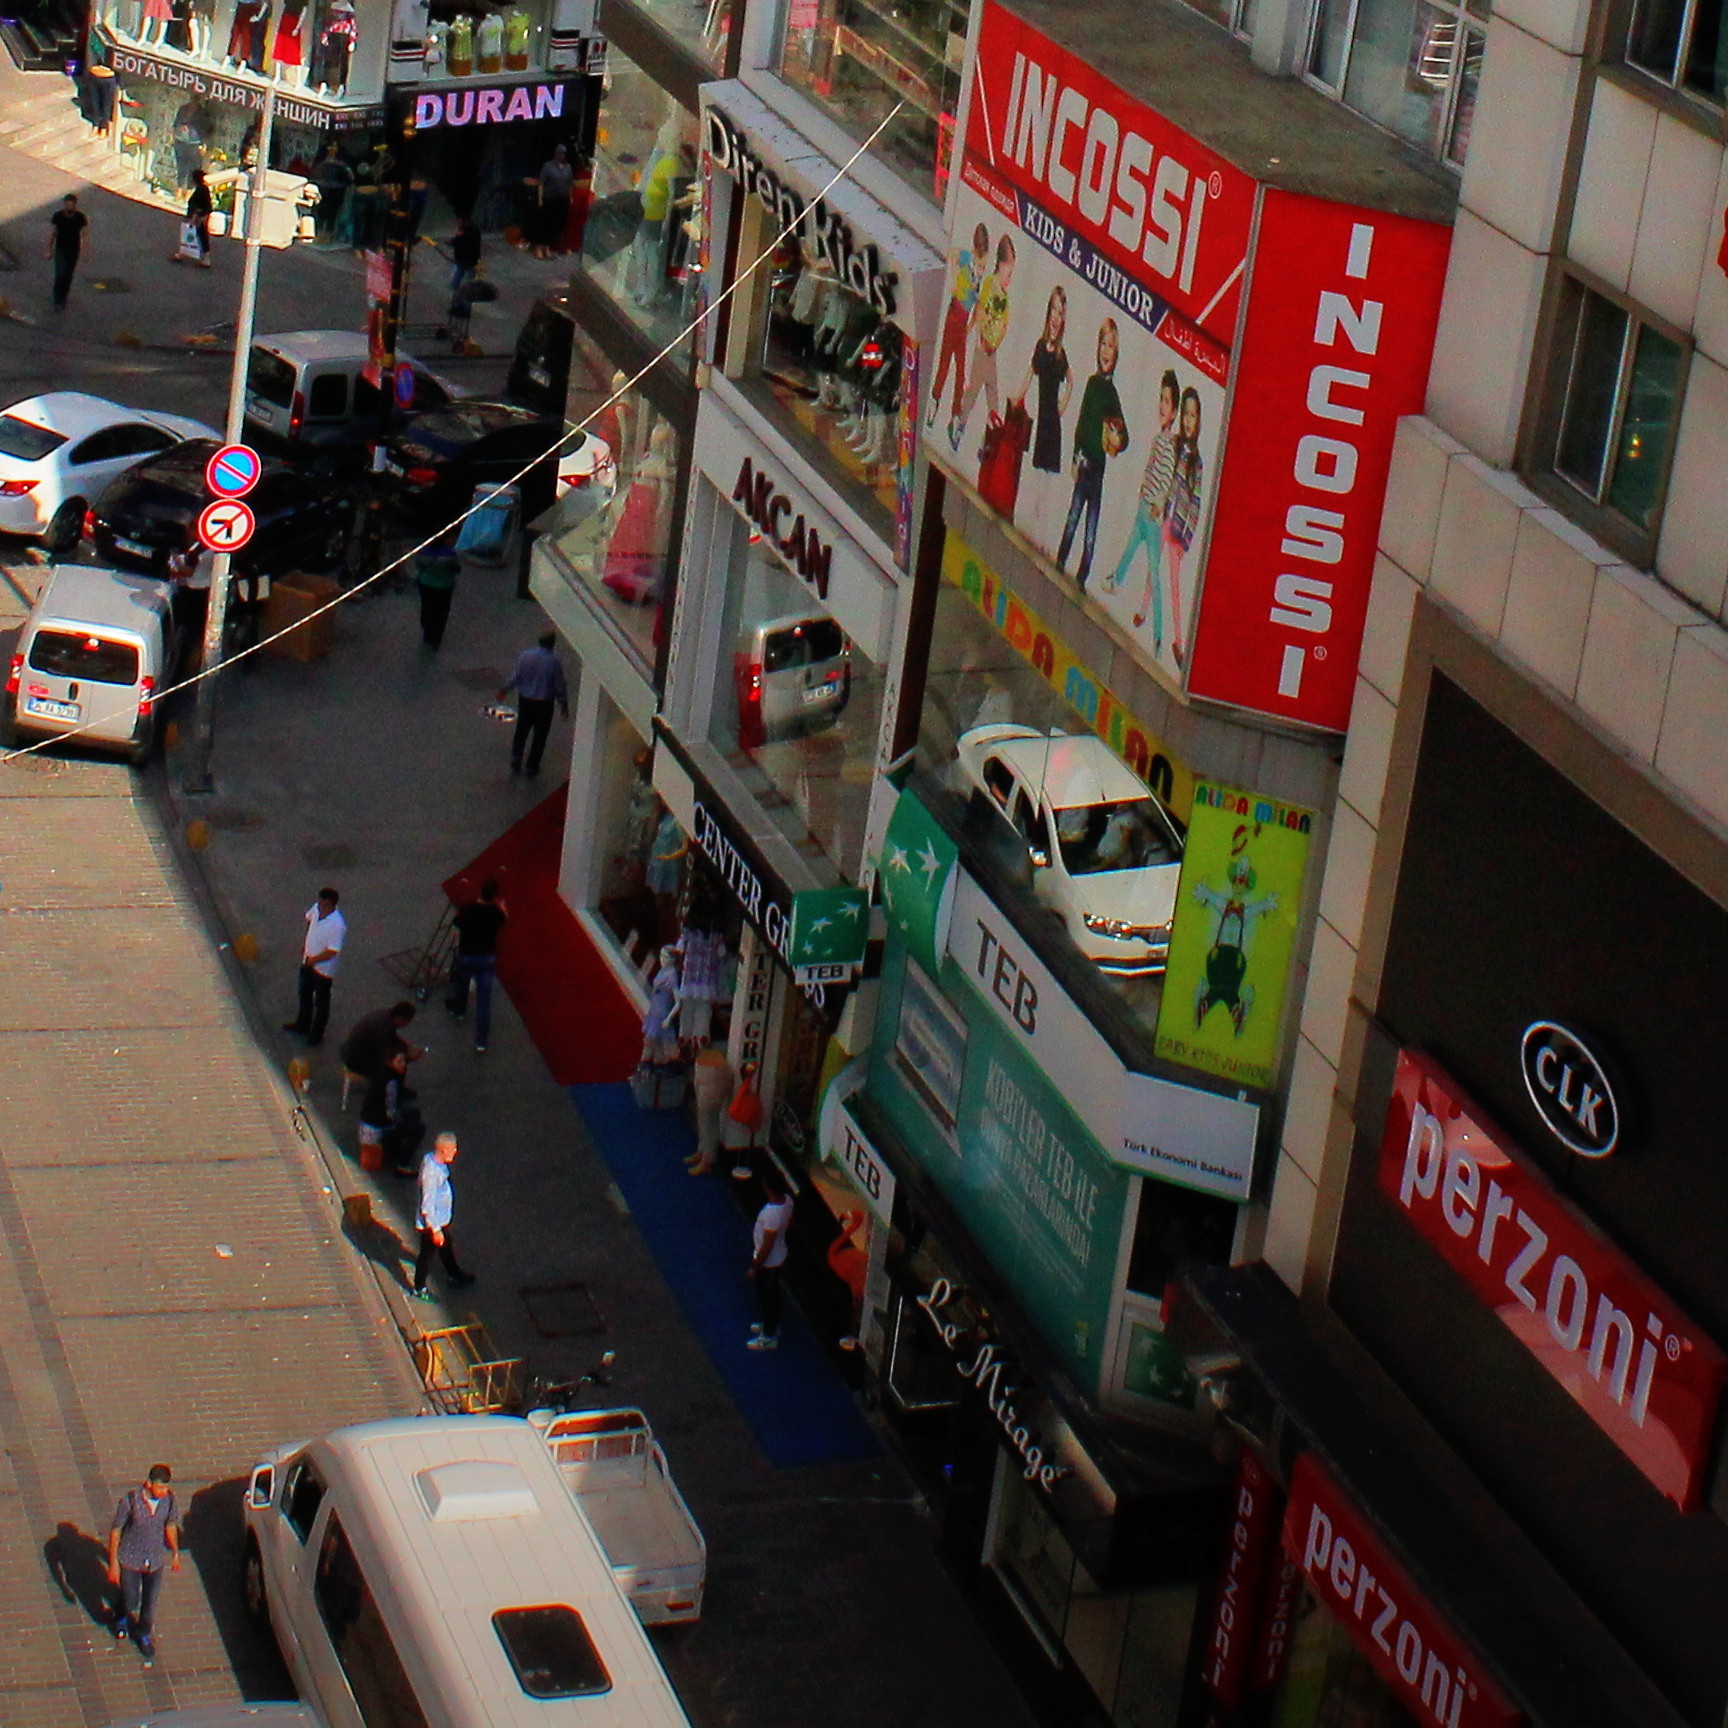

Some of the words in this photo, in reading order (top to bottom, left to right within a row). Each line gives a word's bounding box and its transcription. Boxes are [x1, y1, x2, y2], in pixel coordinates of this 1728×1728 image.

[112, 51, 206, 94] БОГАТЫРЬ
[209, 81, 246, 107] ДЛЯ
[415, 84, 565, 130] DURAN
[706, 104, 805, 239] Diren
[812, 197, 898, 316] Kids
[1002, 51, 1208, 295] INCOSSI
[1024, 203, 1065, 255] KIDS
[1069, 237, 1082, 269] &
[1086, 252, 1156, 325] JUNIOR
[1270, 224, 1384, 699] INCOSSI
[693, 801, 763, 925] CENTER
[806, 965, 845, 979] TEB
[977, 918, 1039, 1036] TEB
[1533, 1042, 1605, 1139] CLK
[844, 1126, 881, 1201] TEB
[1123, 1137, 1147, 1153] Türk
[1150, 1146, 1198, 1170] Ekonomi
[1200, 1161, 1243, 1181] Bankası
[1399, 1100, 1665, 1429] perzoni
[916, 1278, 968, 1350] Le
[957, 1343, 1072, 1493] Mirage
[1303, 1503, 1467, 1728] perzoni
